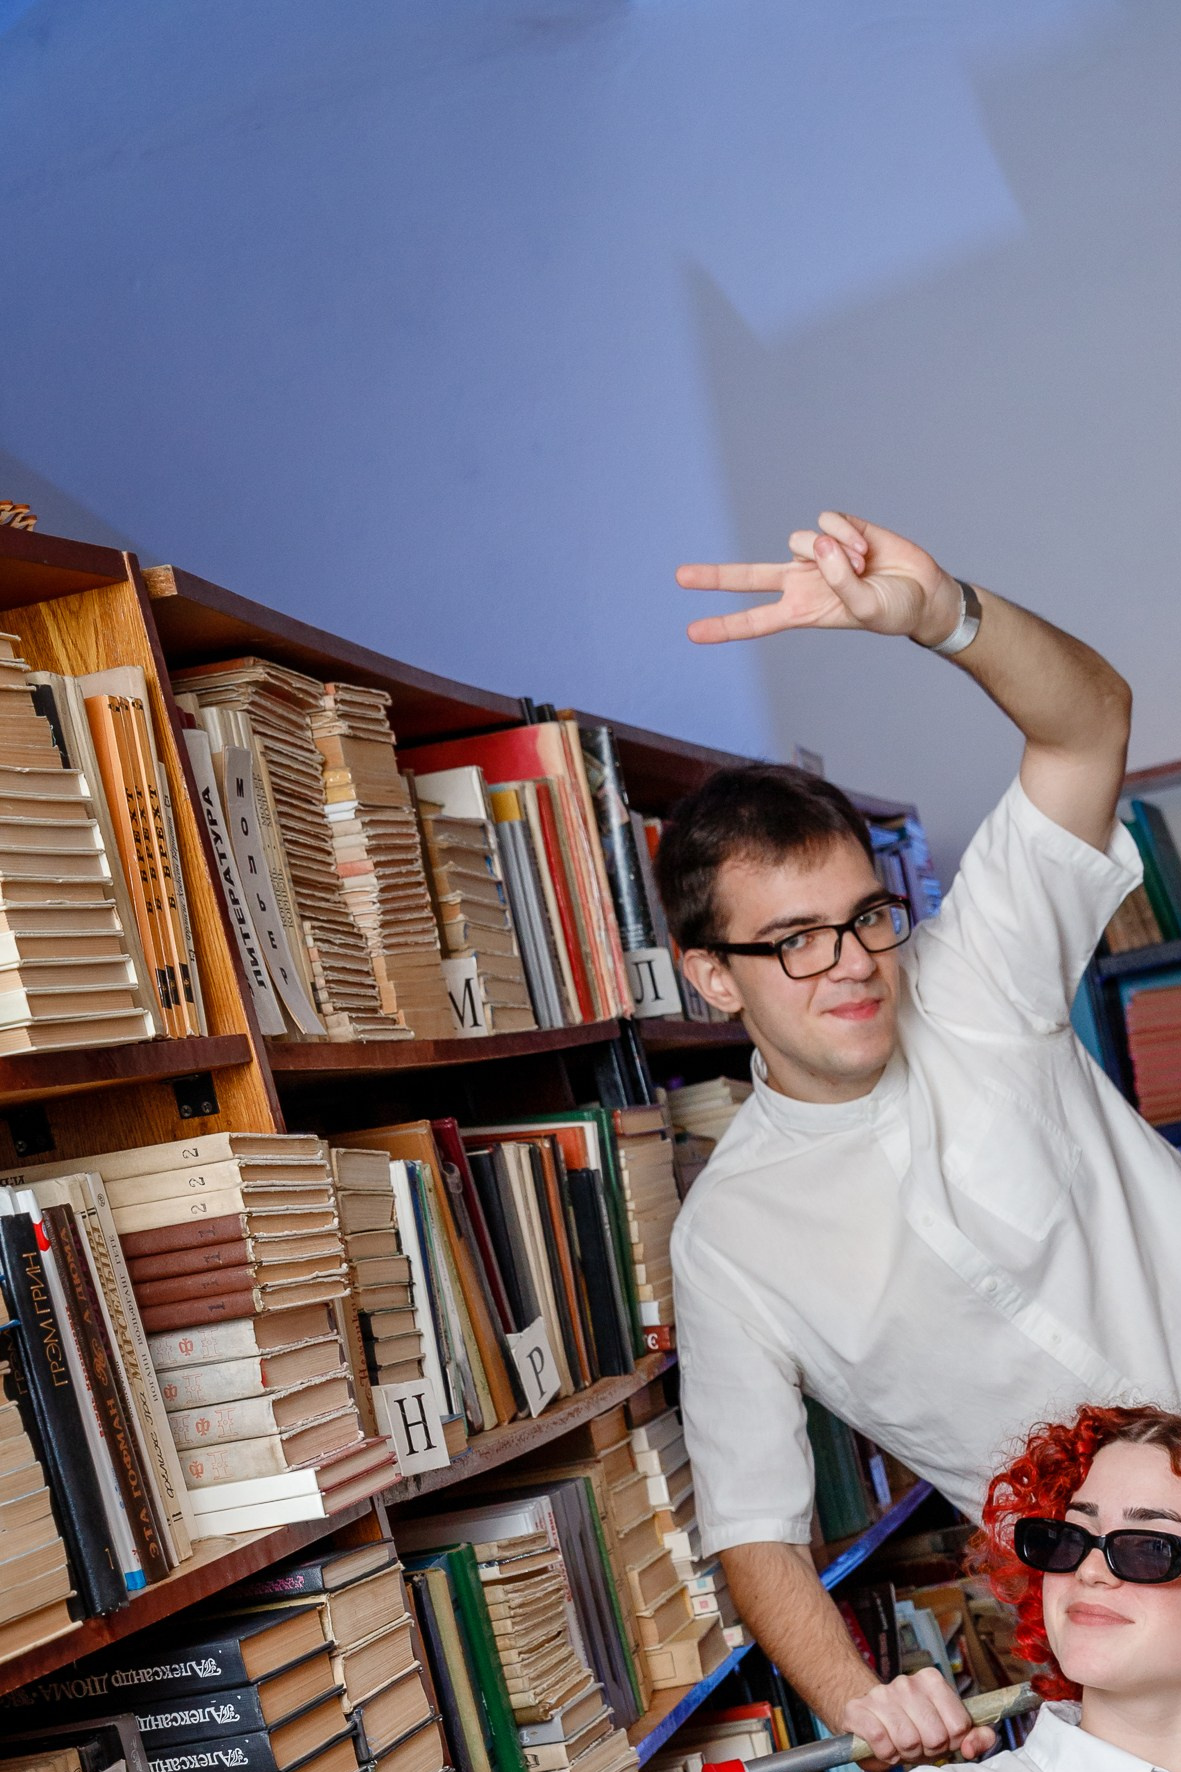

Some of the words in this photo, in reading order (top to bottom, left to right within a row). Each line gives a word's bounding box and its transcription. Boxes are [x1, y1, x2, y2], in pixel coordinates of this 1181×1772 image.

[198, 784, 267, 992] ЛИТЕРАТУРА
[631, 959, 664, 1003] Л
[57, 1226, 86, 1302] ДЮМА
[107, 1234, 122, 1264] ГЕТЕ
[20, 1250, 53, 1315] ГРИН
[117, 1272, 144, 1346] ВОЛЬФГАНГ
[37, 1318, 71, 1387] ГРЭМ
[139, 1353, 159, 1401] ИОГАНН
[526, 1344, 546, 1400] Р
[105, 1396, 143, 1497] ГОФМАН
[394, 1392, 437, 1457] Н
[109, 1655, 221, 1689] Александр
[134, 1702, 240, 1735] Александ
